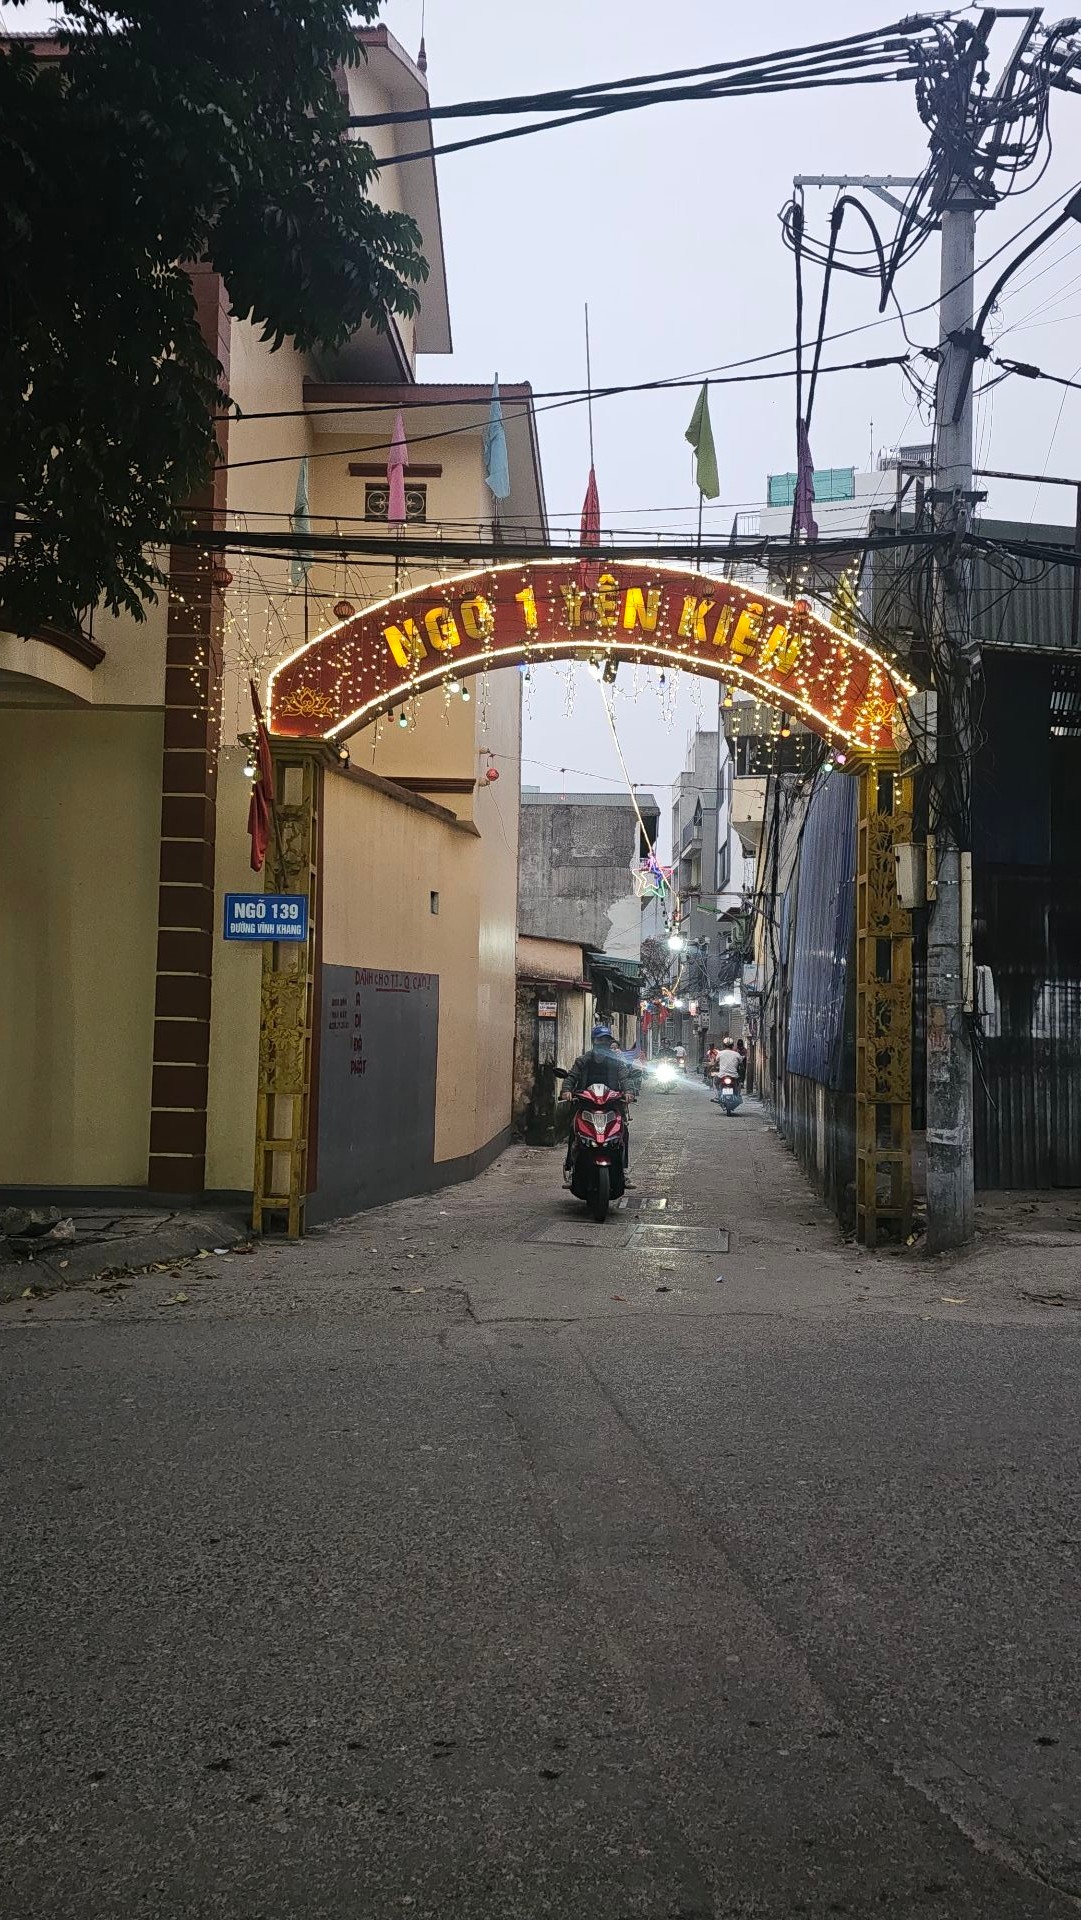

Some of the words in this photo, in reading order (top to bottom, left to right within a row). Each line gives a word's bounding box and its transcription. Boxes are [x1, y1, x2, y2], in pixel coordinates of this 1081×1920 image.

[515, 587, 539, 630] 1
[560, 574, 662, 632] YÊN
[234, 899, 266, 919] NGÕ
[271, 903, 299, 920] 139
[230, 921, 256, 934] ĐƯỜNG
[257, 921, 275, 934] VĨNH
[276, 924, 302, 935] KHANG
